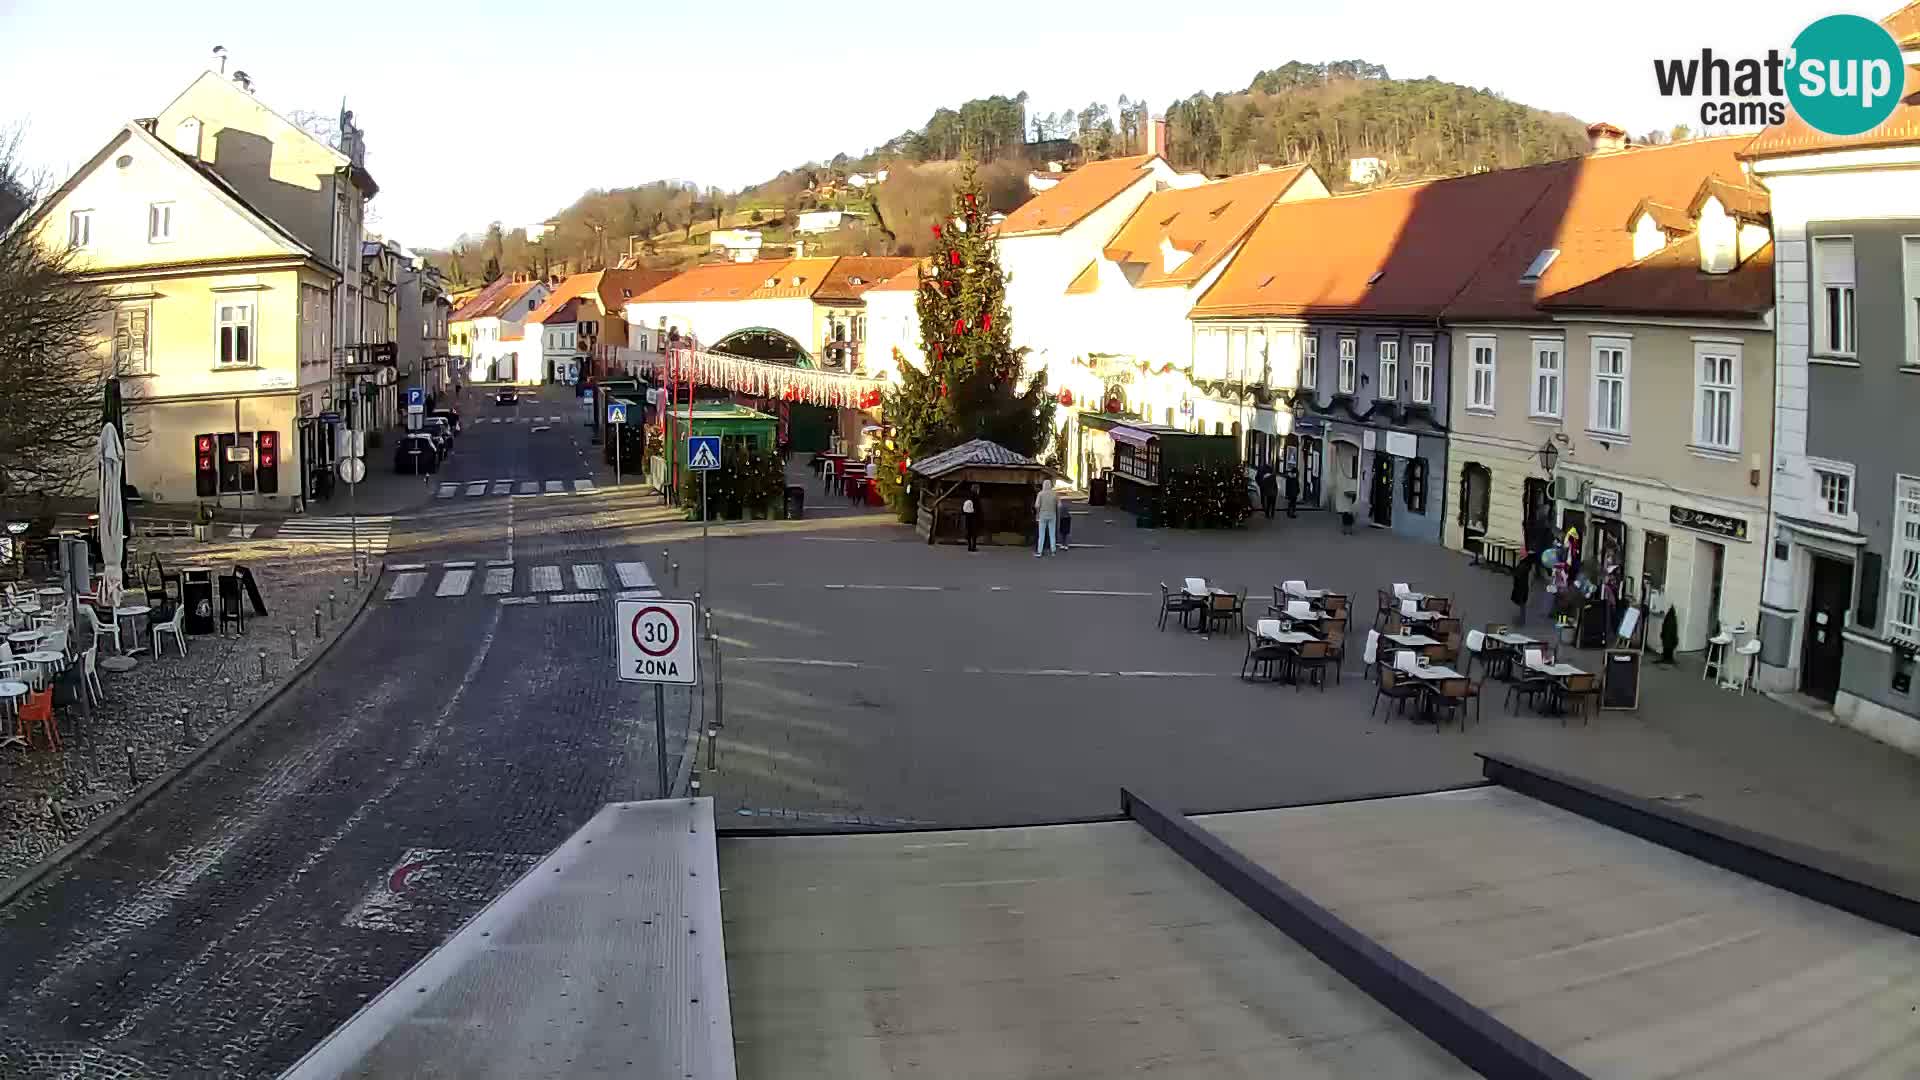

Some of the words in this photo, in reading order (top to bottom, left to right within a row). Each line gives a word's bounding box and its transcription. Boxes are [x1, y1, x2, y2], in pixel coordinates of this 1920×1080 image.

[411, 391, 420, 403] P
[645, 622, 668, 643] 30
[635, 659, 679, 676] ZONA
